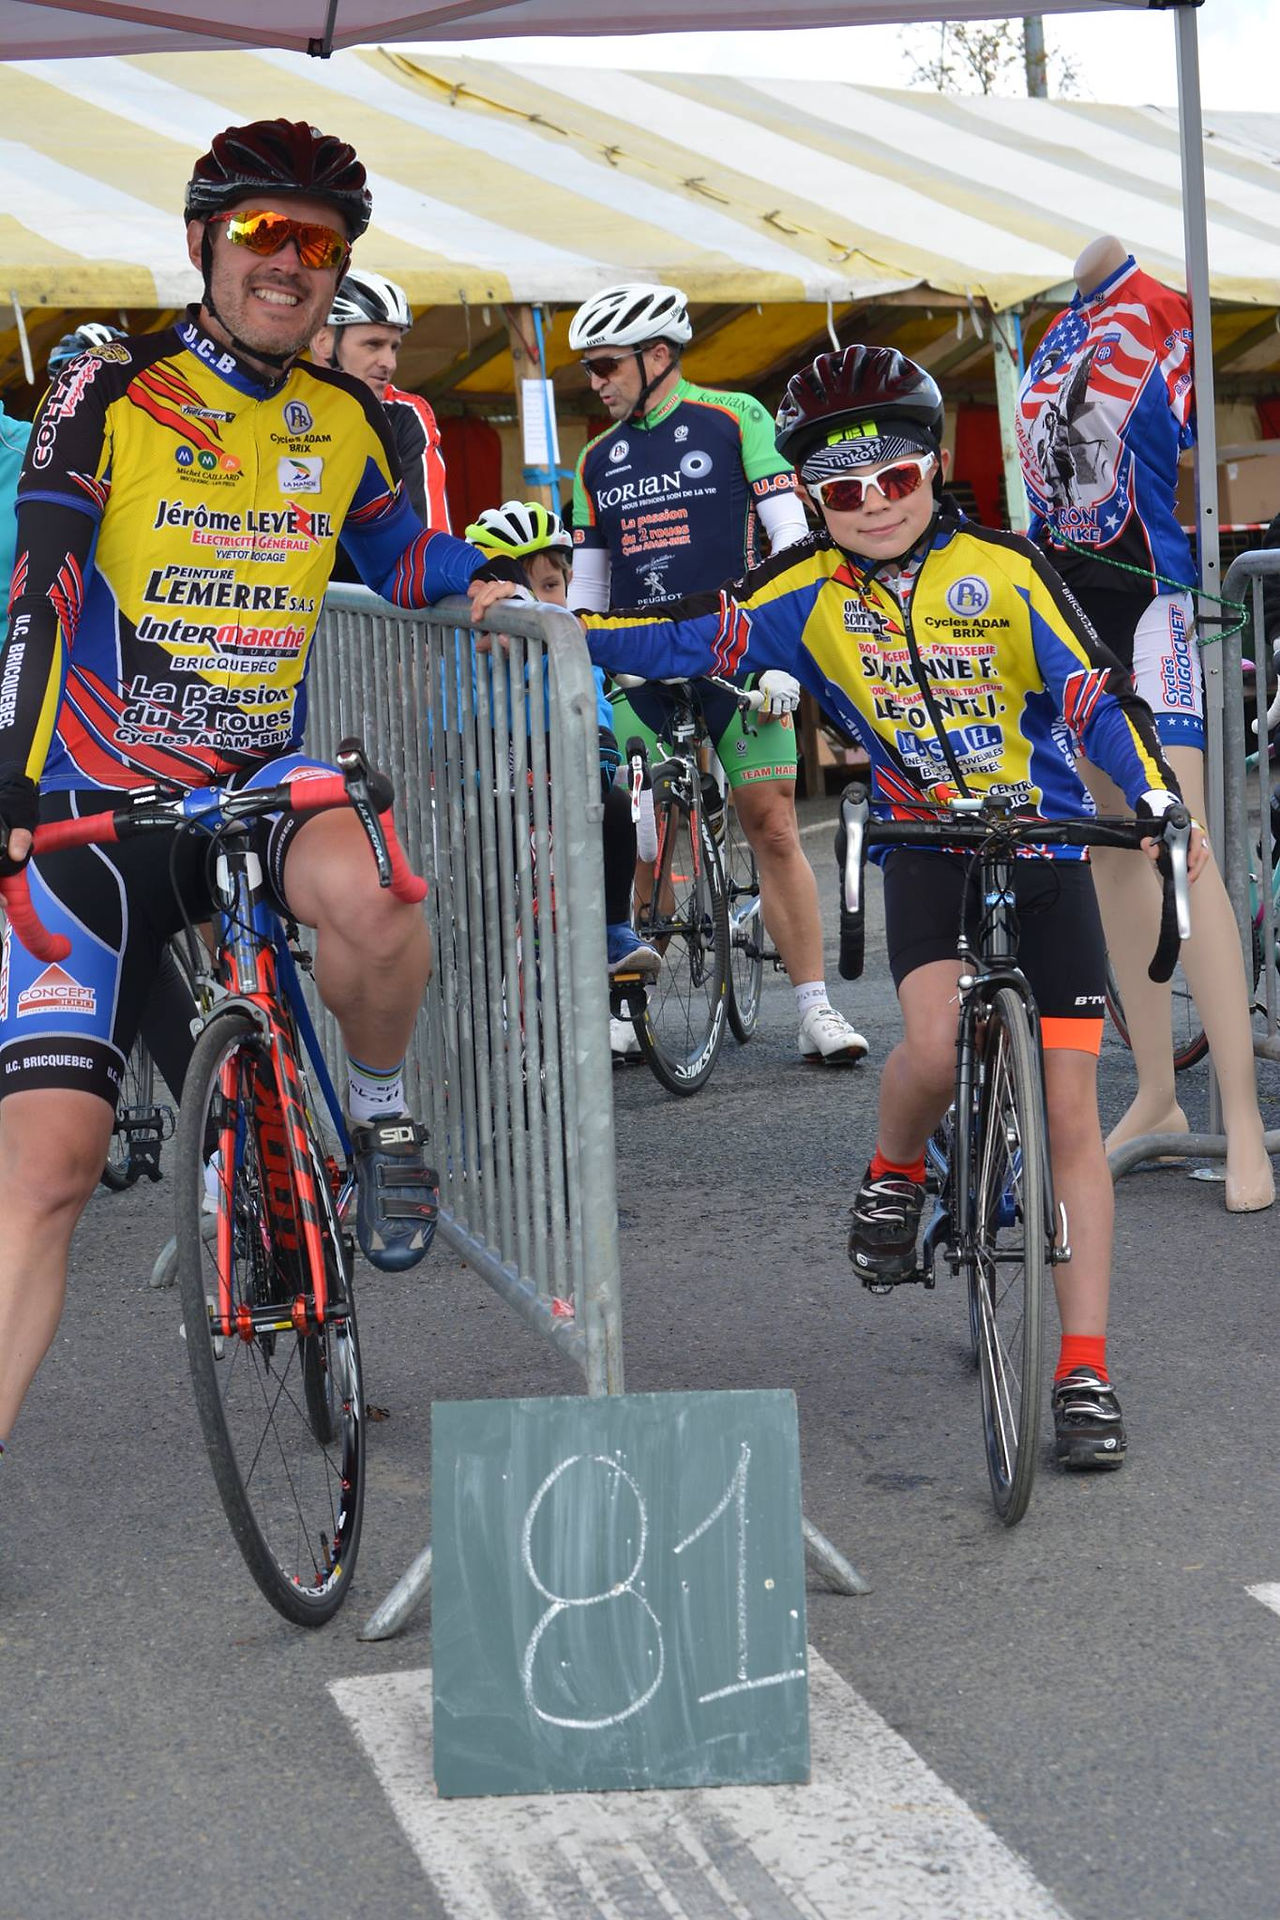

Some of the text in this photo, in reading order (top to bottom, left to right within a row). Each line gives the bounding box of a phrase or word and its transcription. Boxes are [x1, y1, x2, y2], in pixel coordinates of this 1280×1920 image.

[304, 434, 332, 443] ADAM
[826, 443, 882, 468] Tinkoff
[596, 471, 681, 511] KORIaN
[154, 500, 241, 530] Jérôme
[216, 550, 249, 559] YVETOT
[165, 565, 235, 580] PEINTURE
[144, 570, 289, 611] LEMERRE
[925, 617, 1010, 629] Cycles ADAM
[953, 629, 985, 638] BRIX
[932, 644, 996, 657] PATISSERIE
[1164, 607, 1193, 707] Cycles DUGOCHET
[173, 657, 277, 673] BRICQUEBEC
[131, 676, 290, 709] La passion
[122, 703, 292, 732] du 2 roues
[115, 727, 190, 746] Cycles
[742, 766, 771, 780] TEAM
[357, 803, 385, 864] ULTEGRA
[19, 987, 94, 1002] CONCEPT
[5, 1054, 94, 1073] U.C. BRICQUEBEC
[522, 1441, 806, 1729] 81
